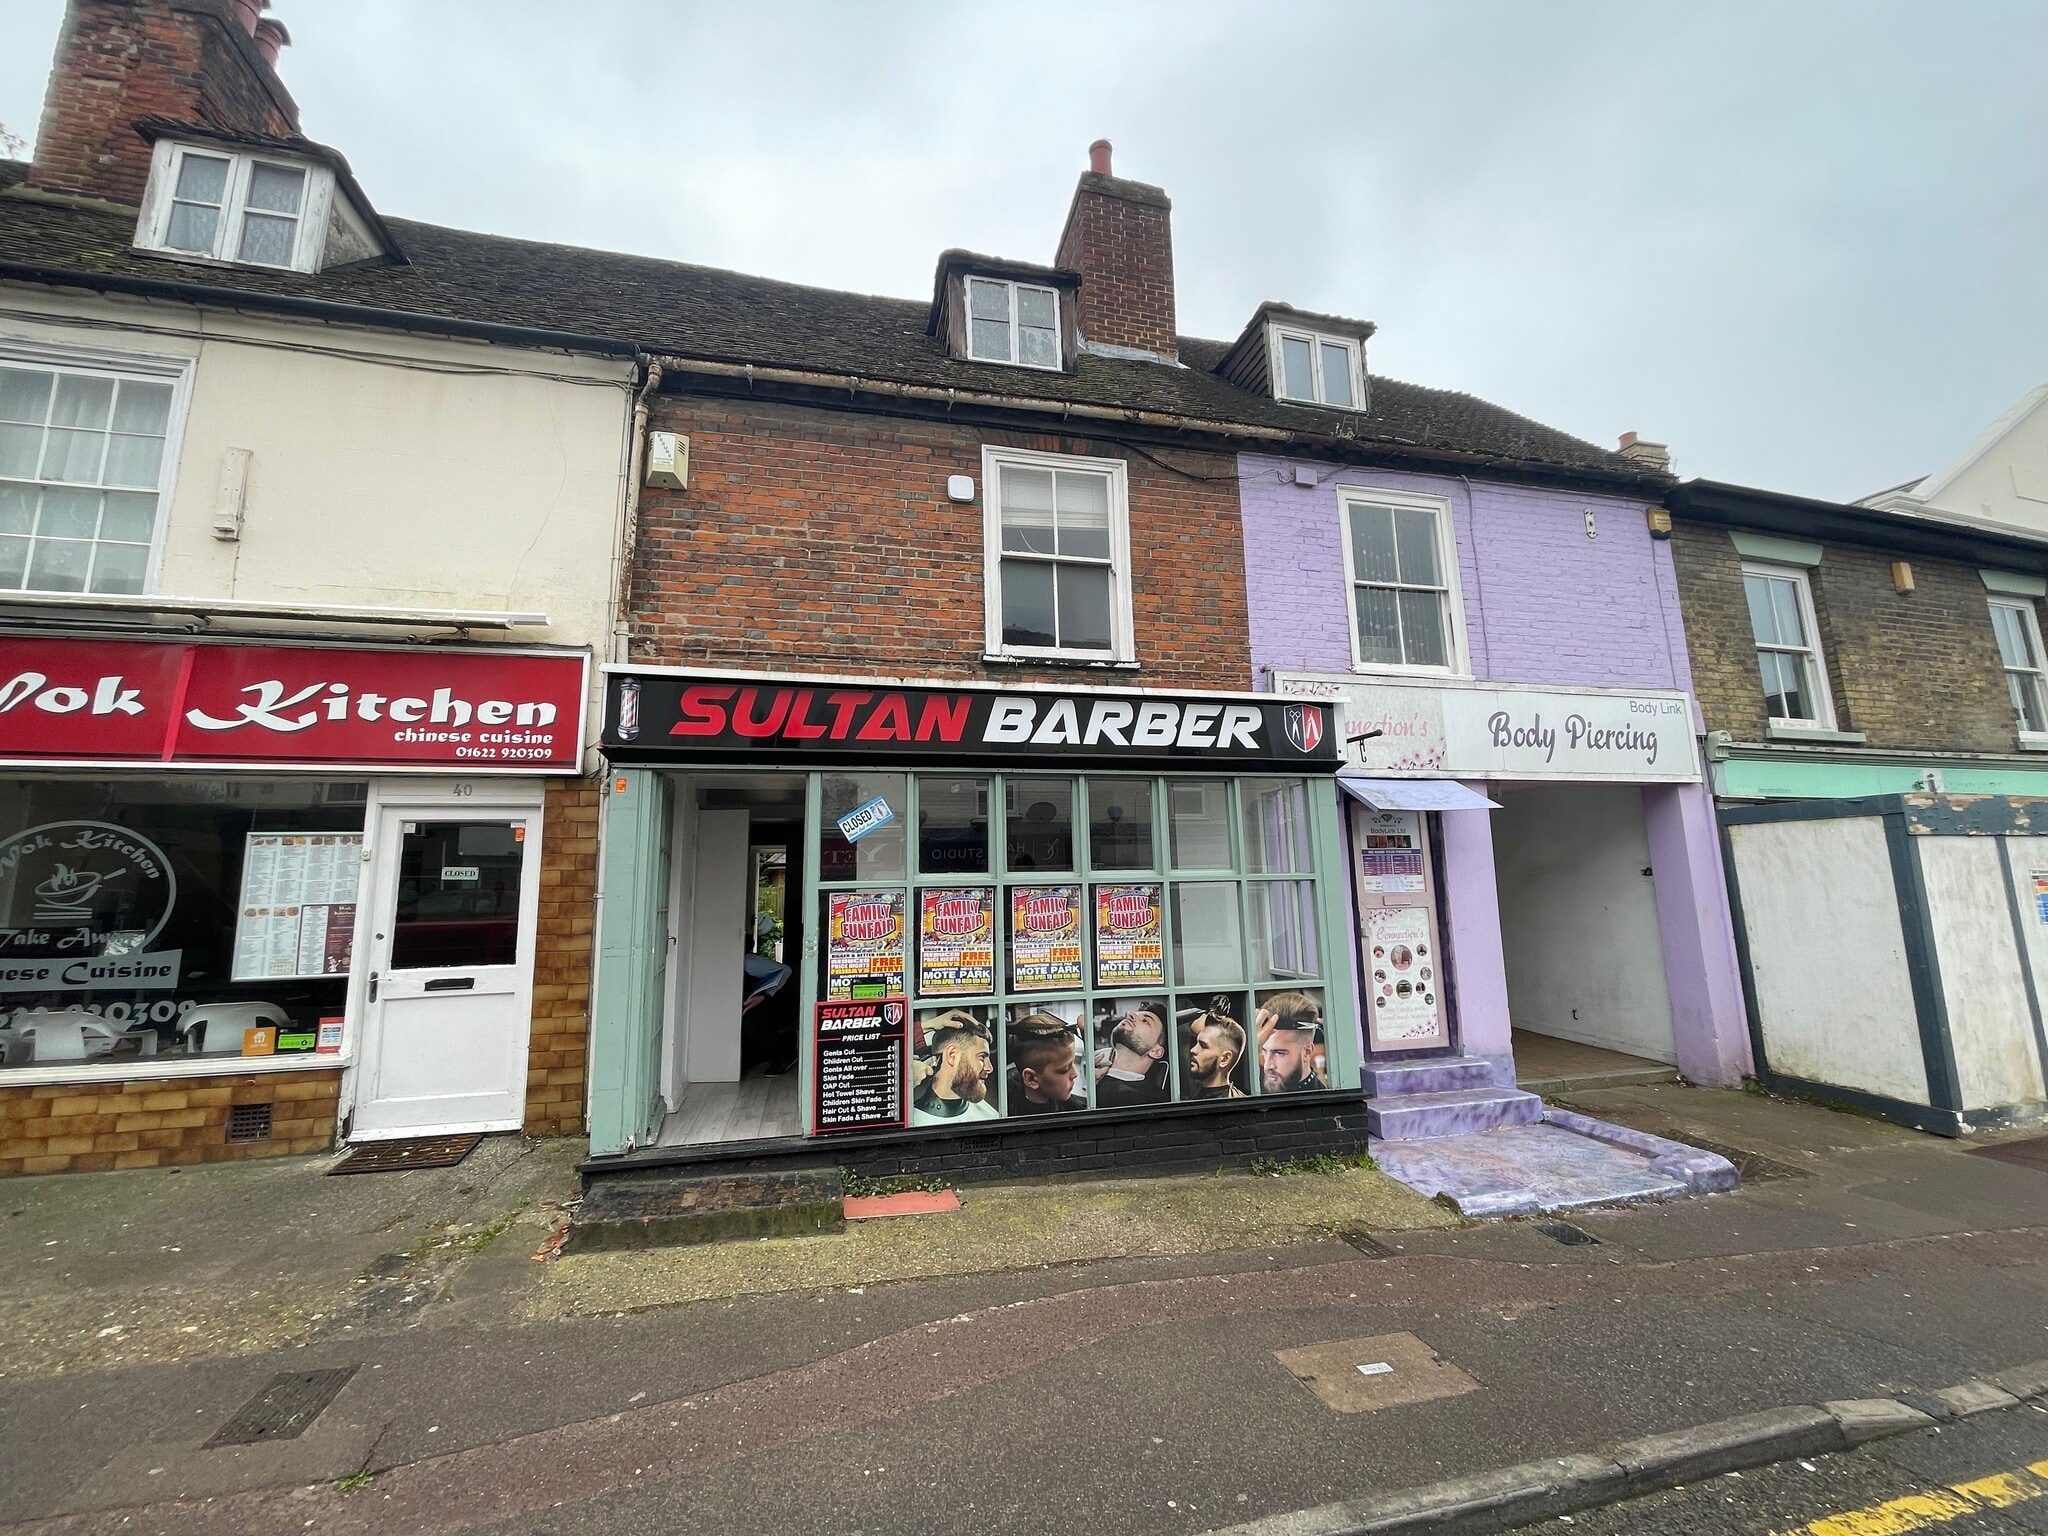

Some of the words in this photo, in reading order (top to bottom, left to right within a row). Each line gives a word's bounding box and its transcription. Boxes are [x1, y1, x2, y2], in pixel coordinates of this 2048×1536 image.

[185, 680, 557, 731] Kitchen
[1629, 700, 1658, 716] Body
[1660, 702, 1682, 715] Link
[669, 686, 973, 743] SULTAN
[982, 697, 1263, 749] BARBER
[394, 727, 471, 744] chinese
[479, 729, 553, 745] cuisine
[1487, 711, 1555, 763] Body
[1565, 713, 1658, 765] Piercing
[456, 746, 496, 758] 01622
[501, 747, 552, 759] 920309
[453, 783, 473, 797] 40
[842, 809, 872, 834] CLOSED
[60, 830, 160, 879] Kitchen
[936, 900, 979, 917] FAMILY
[1026, 898, 1067, 914] FAMILY
[1110, 896, 1149, 912] FAMILY
[844, 904, 891, 922] FAMILY
[1024, 911, 1071, 931] FUNFAIR
[1108, 909, 1152, 928] FUNFAIR
[842, 919, 895, 939] FUNFAIR
[934, 913, 983, 934] FUNFAIR
[963, 952, 991, 960] FREE
[1053, 948, 1079, 956] FREE
[1135, 945, 1160, 953] FREE
[873, 957, 903, 966] FREE
[1100, 963, 1129, 971] MOTE
[1133, 962, 1160, 970] PARK
[62, 961, 172, 985] Cuisine
[924, 971, 956, 979] MOTE
[960, 970, 990, 978] PARK
[1016, 966, 1047, 975] MOTE
[1051, 965, 1080, 974] PARK
[821, 1006, 876, 1019] SULTAN
[821, 1017, 882, 1031] BARBER
[842, 1034, 864, 1042] PRICE
